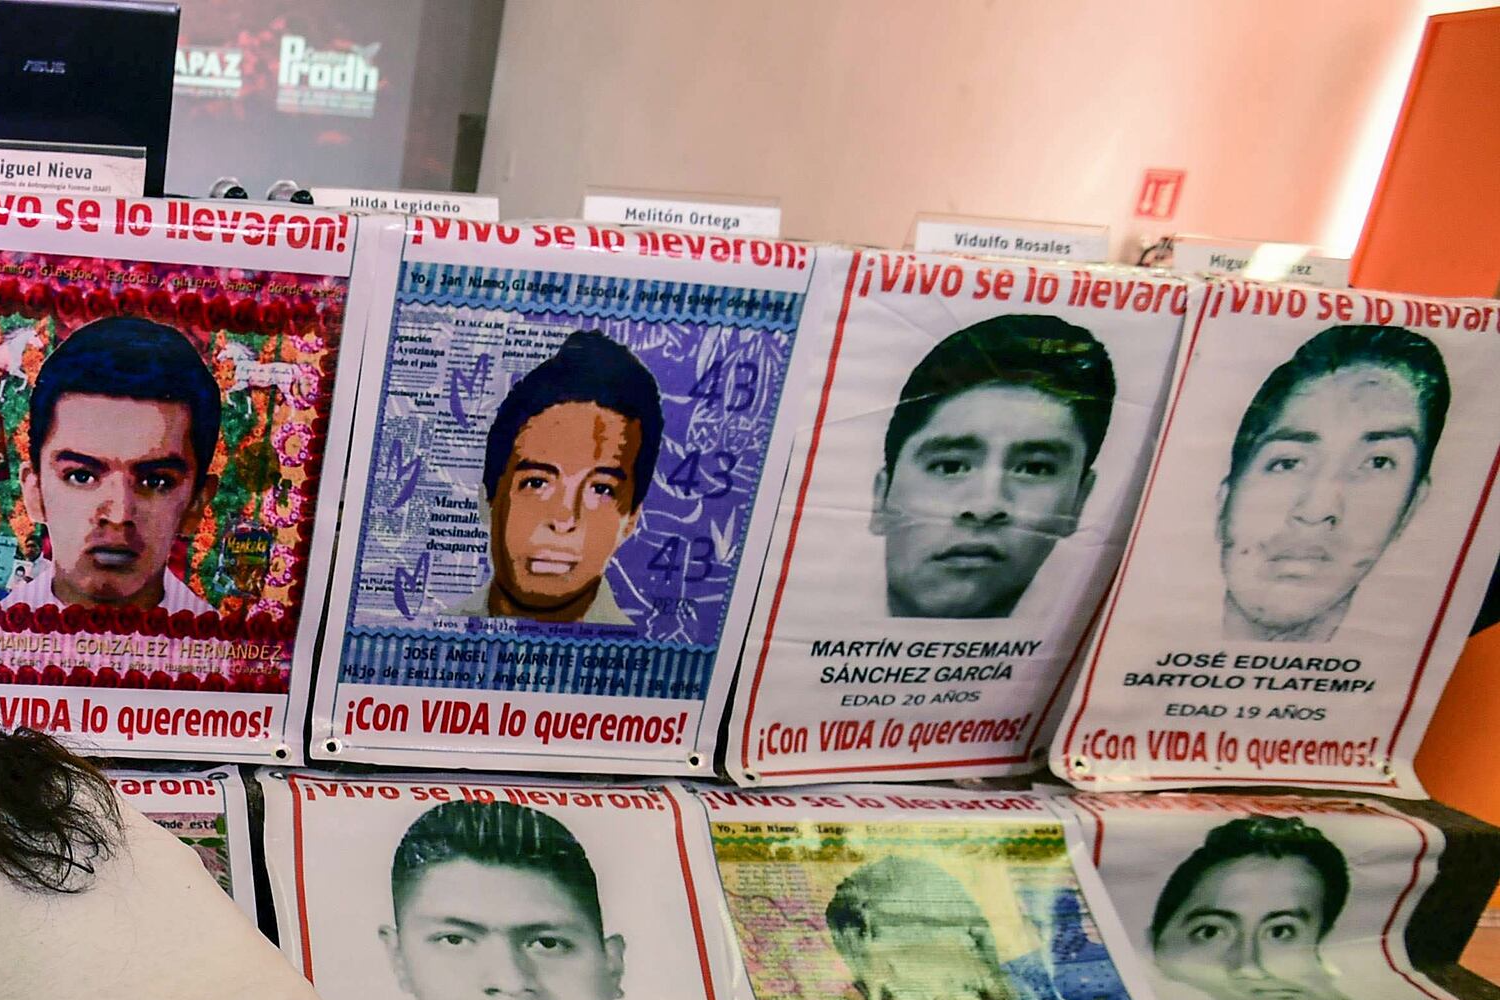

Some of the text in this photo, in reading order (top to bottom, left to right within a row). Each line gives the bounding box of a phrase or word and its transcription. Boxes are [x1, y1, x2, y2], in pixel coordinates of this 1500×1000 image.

[22, 60, 66, 73] ASUS
[279, 34, 379, 92] Prodh
[48, 161, 92, 179] Nieva
[350, 197, 460, 214] Hilda Legideño
[55, 196, 102, 234] se
[115, 197, 154, 238] lo
[165, 199, 350, 254] llevaron!
[625, 208, 740, 230] Melitón Ortega
[954, 232, 1071, 255] Vidulfo Rosales
[411, 271, 462, 287] Yo, Jan
[858, 250, 1016, 301] ¡Vivo se
[689, 360, 758, 412] 43
[666, 450, 737, 500] 43
[434, 496, 478, 510] Marcha
[647, 535, 716, 584] 43
[75, 635, 168, 659] GONZÁLEZ
[181, 640, 283, 662] HERNÁNDEZ
[404, 646, 438, 661] JOSÉ
[446, 646, 487, 664] ÁNGEL
[499, 650, 574, 668] NAVARRETE
[811, 637, 1042, 659] MARTÍN GETSEMANY
[343, 663, 470, 683] Hijo de Emiliano
[820, 661, 1012, 684] SÁNCHEZ GARCÍA
[1156, 651, 1361, 673] JOSÉ EDUARDO
[1123, 673, 1245, 690] BARTOLO
[841, 688, 981, 707] EDAD 20 AÑOS
[81, 698, 273, 742] lo queremos!
[343, 695, 689, 747] ¡Con VIDA lo queremos!
[1165, 703, 1327, 721] EDAD 19 AÑOS
[758, 712, 1032, 758] ¡Con VIDA lo queremos!
[1080, 727, 1379, 768] ¡Con VIDA lo queremos!
